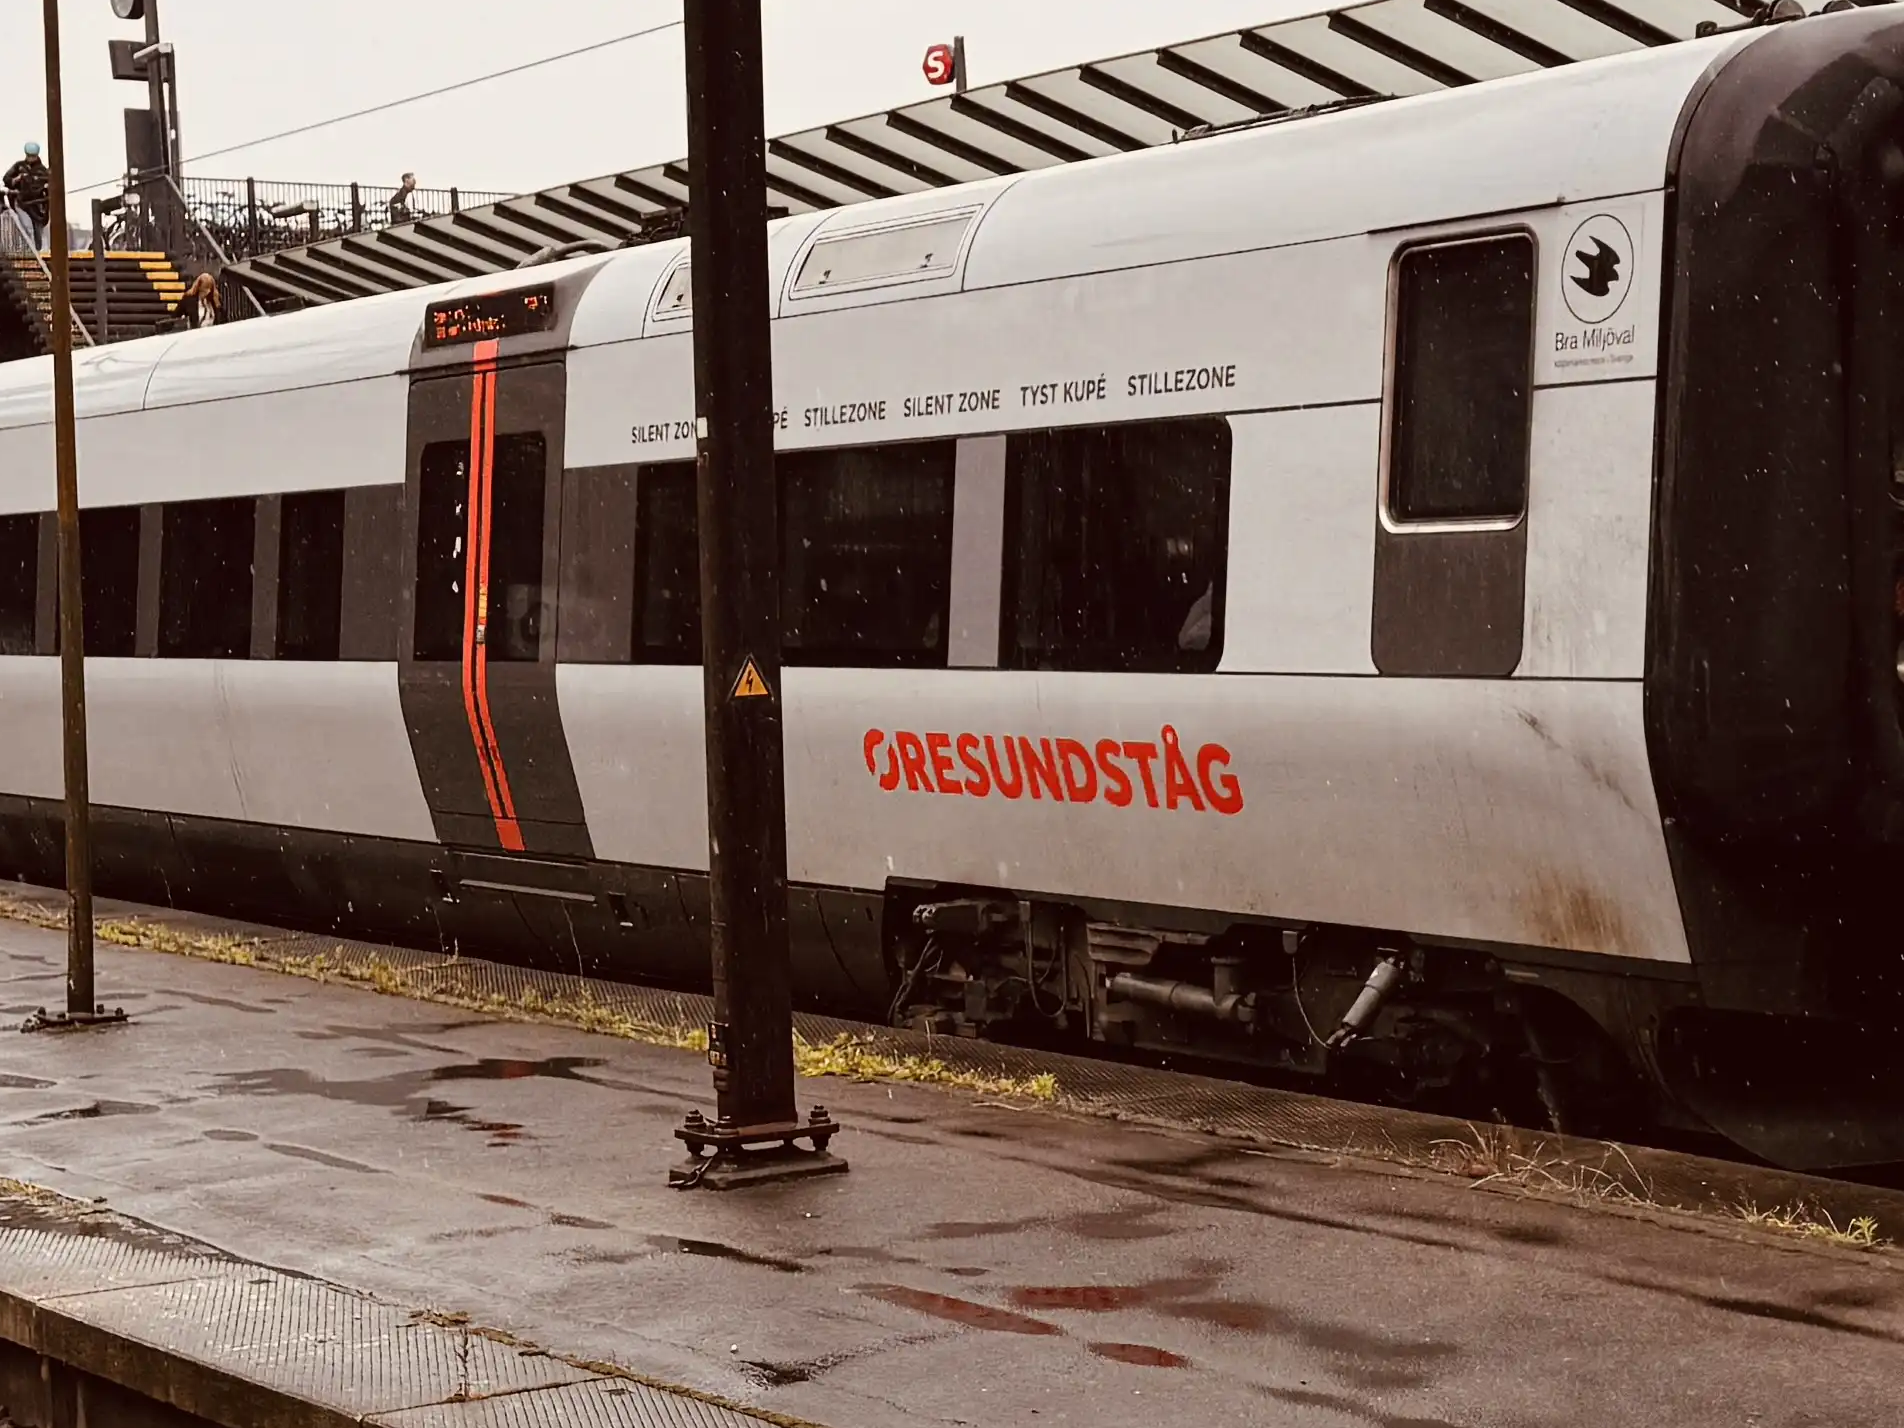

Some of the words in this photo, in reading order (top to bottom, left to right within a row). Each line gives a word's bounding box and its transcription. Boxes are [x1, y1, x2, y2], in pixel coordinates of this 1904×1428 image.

[927, 50, 945, 79] S
[1555, 332, 1578, 351] Bra
[631, 421, 670, 444] SILENT
[674, 420, 697, 440] ZON
[773, 406, 788, 430] PÉ
[804, 400, 886, 428] STILLEZONE
[903, 393, 954, 418] SILENT
[959, 389, 1001, 413] ZONE
[1020, 382, 1059, 407] TYST
[1063, 373, 1107, 403] KUPÉ
[1127, 365, 1237, 397] STILLEZONE
